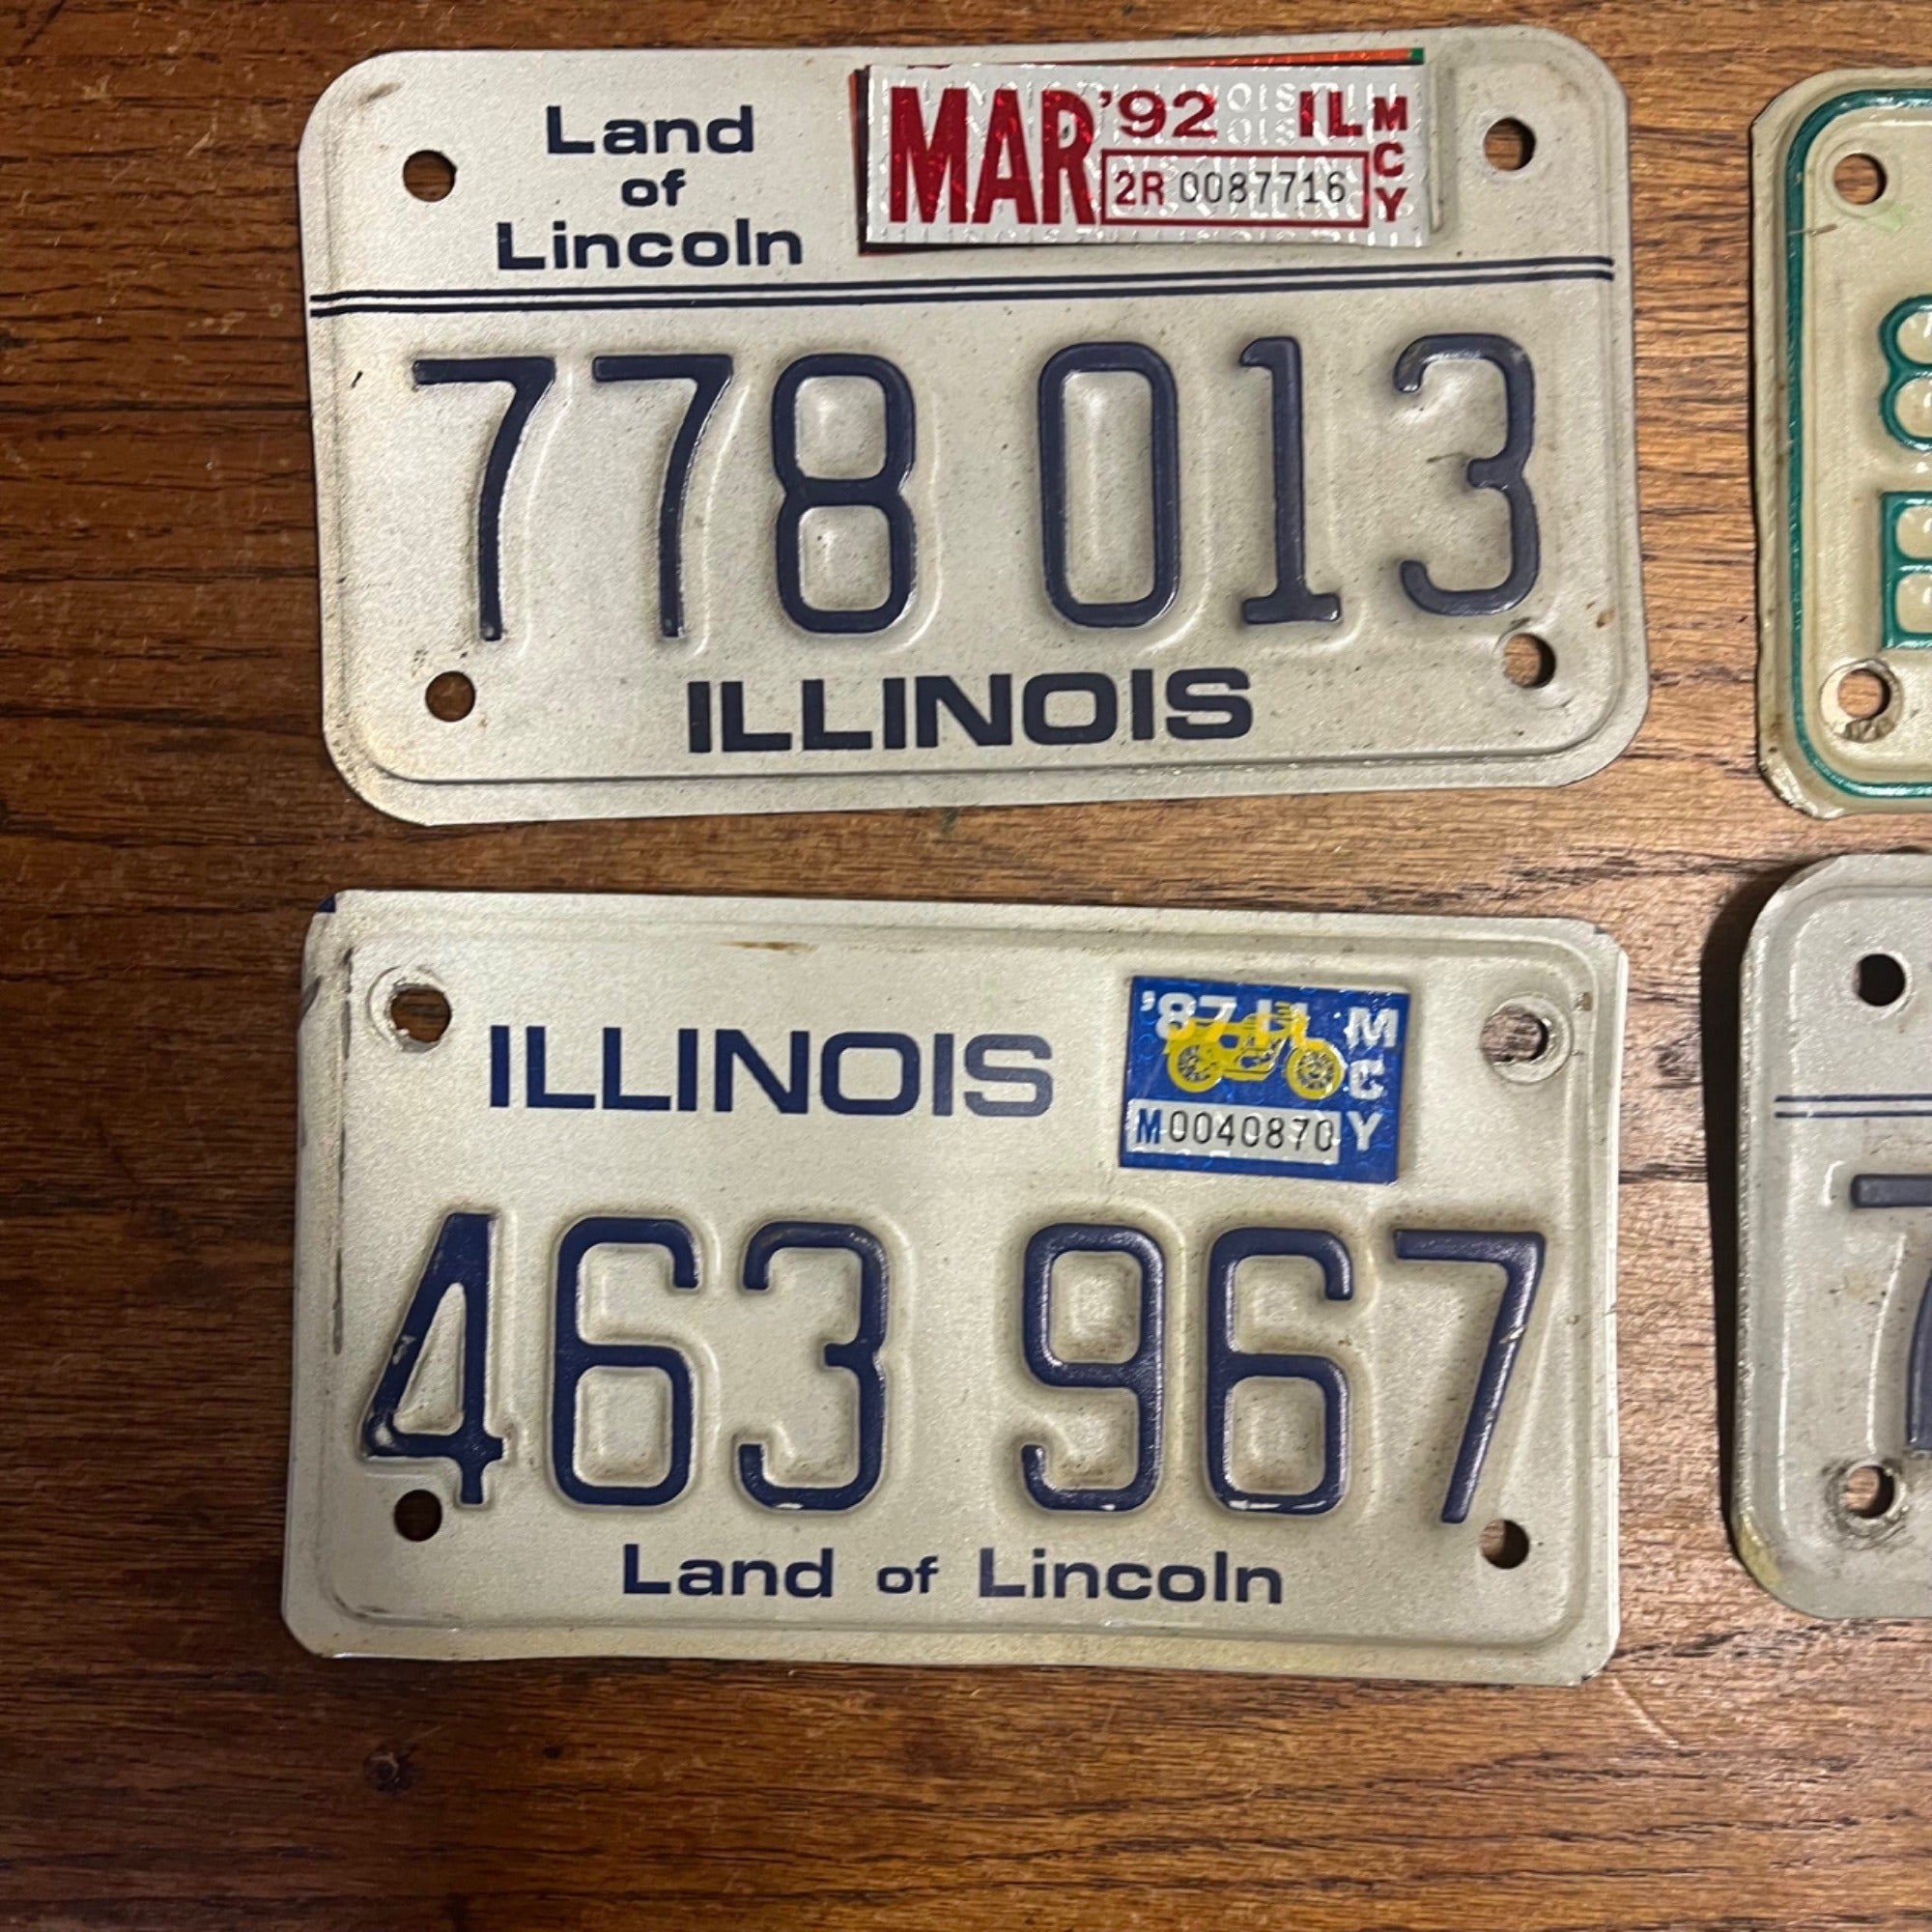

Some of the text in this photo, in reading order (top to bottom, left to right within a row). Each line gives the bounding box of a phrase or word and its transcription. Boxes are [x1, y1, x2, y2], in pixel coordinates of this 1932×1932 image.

[546, 104, 755, 155] Land
[889, 86, 1102, 226] MAR
[1099, 89, 1218, 139] '92
[1299, 90, 1364, 138] IL
[620, 167, 688, 208] of
[1114, 169, 1348, 207] 2R 0087716
[496, 218, 804, 270] Lincoln
[412, 352, 916, 642] 778
[1037, 332, 1542, 629] 013
[687, 666, 1255, 753] ILLINOIS
[489, 1024, 1055, 1118] ILLINOIS
[362, 1211, 892, 1512] 463
[1020, 1222, 1547, 1525] 967
[622, 1543, 1284, 1605] Land of Lincoln
